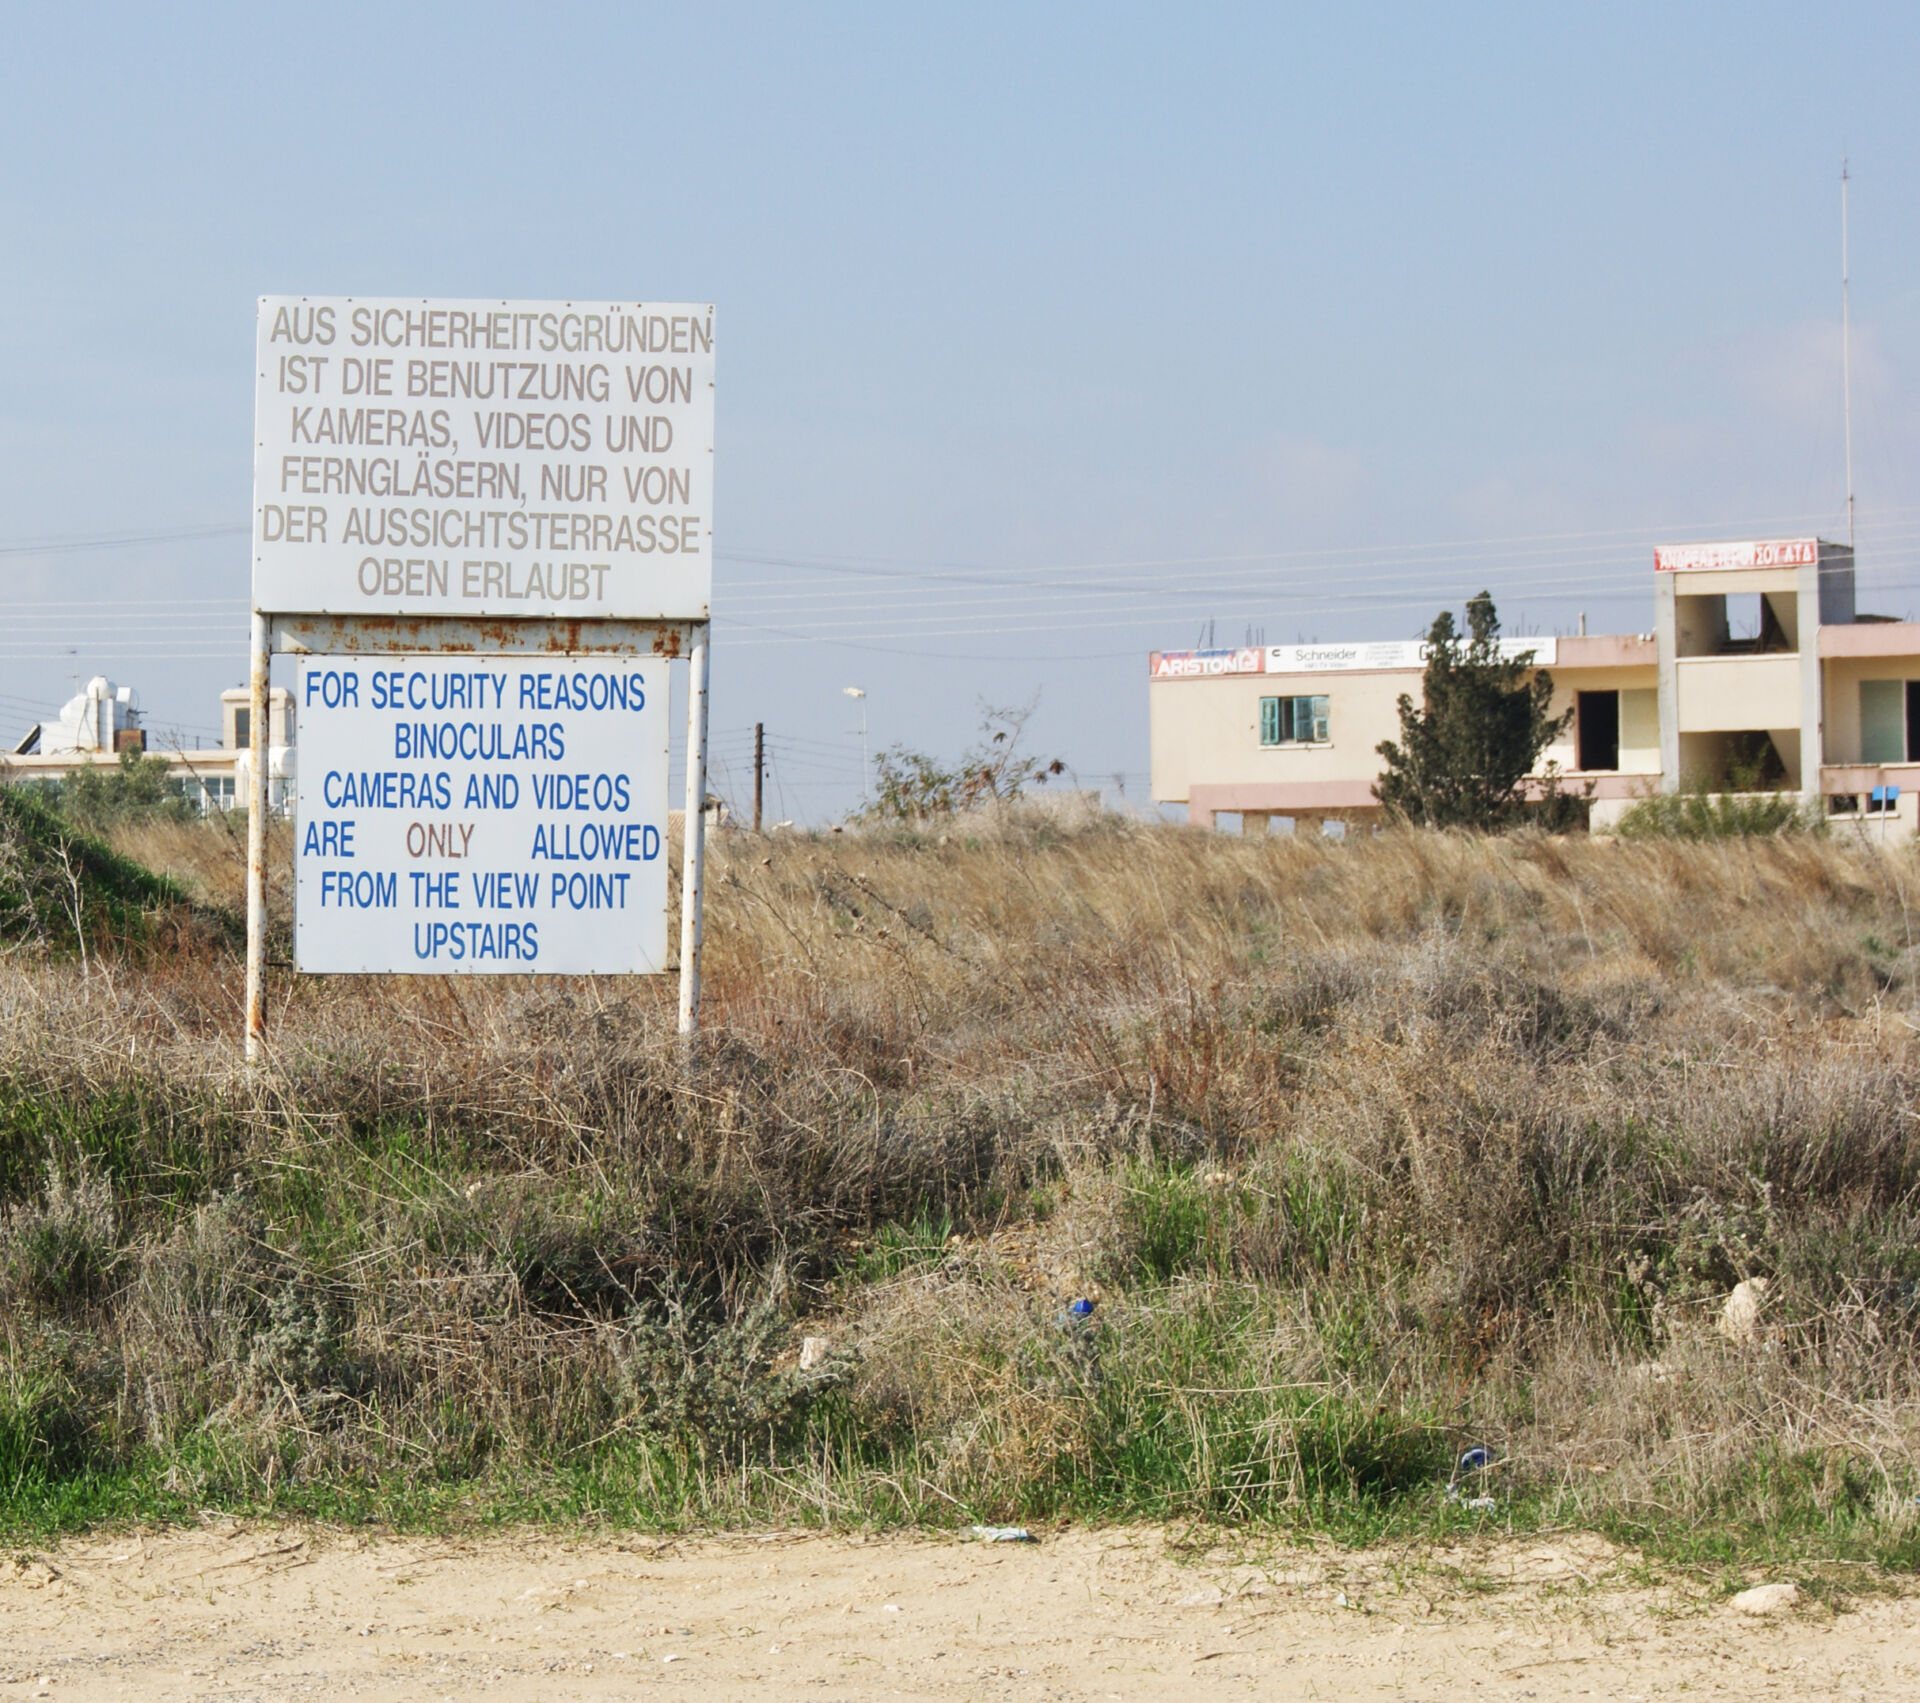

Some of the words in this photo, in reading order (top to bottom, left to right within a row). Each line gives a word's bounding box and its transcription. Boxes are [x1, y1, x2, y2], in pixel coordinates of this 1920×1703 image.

[271, 307, 336, 345] AUS
[351, 306, 711, 353] SICHERHEITSGRÜNDEN
[280, 355, 329, 394] IST
[342, 358, 394, 396] DIE
[408, 360, 609, 402] BENUTZUNG
[626, 365, 692, 404] VON
[292, 406, 458, 454] KAMERAS,
[474, 412, 591, 452] VIDEOS
[606, 415, 673, 453] UND
[282, 452, 526, 506] FERNGLÄSERN,
[541, 464, 607, 502] NUR
[624, 466, 690, 505] VON
[264, 505, 327, 543] DER
[343, 508, 700, 553] AUSSICHTSTERRASSE
[358, 557, 448, 597] OBEN
[462, 561, 611, 601] ERLAUBT
[1157, 656, 1238, 676] ARISTON
[1296, 648, 1357, 662] Schneider
[306, 671, 359, 709] FOR
[371, 671, 507, 710] SECURITY
[519, 672, 645, 712] REASONS
[395, 722, 565, 761] BINOCULARS
[323, 770, 451, 811] CAMERAS
[464, 773, 520, 810] AND
[531, 773, 630, 813] VIDEOS
[303, 820, 355, 858] ARE
[407, 822, 475, 859] ONLY
[531, 823, 660, 861] ALLOWED
[321, 870, 397, 909] FROM
[409, 872, 460, 909] THE
[472, 872, 540, 909] VIEW
[551, 872, 631, 910] POINT
[414, 921, 539, 962] UPSTAIRS
